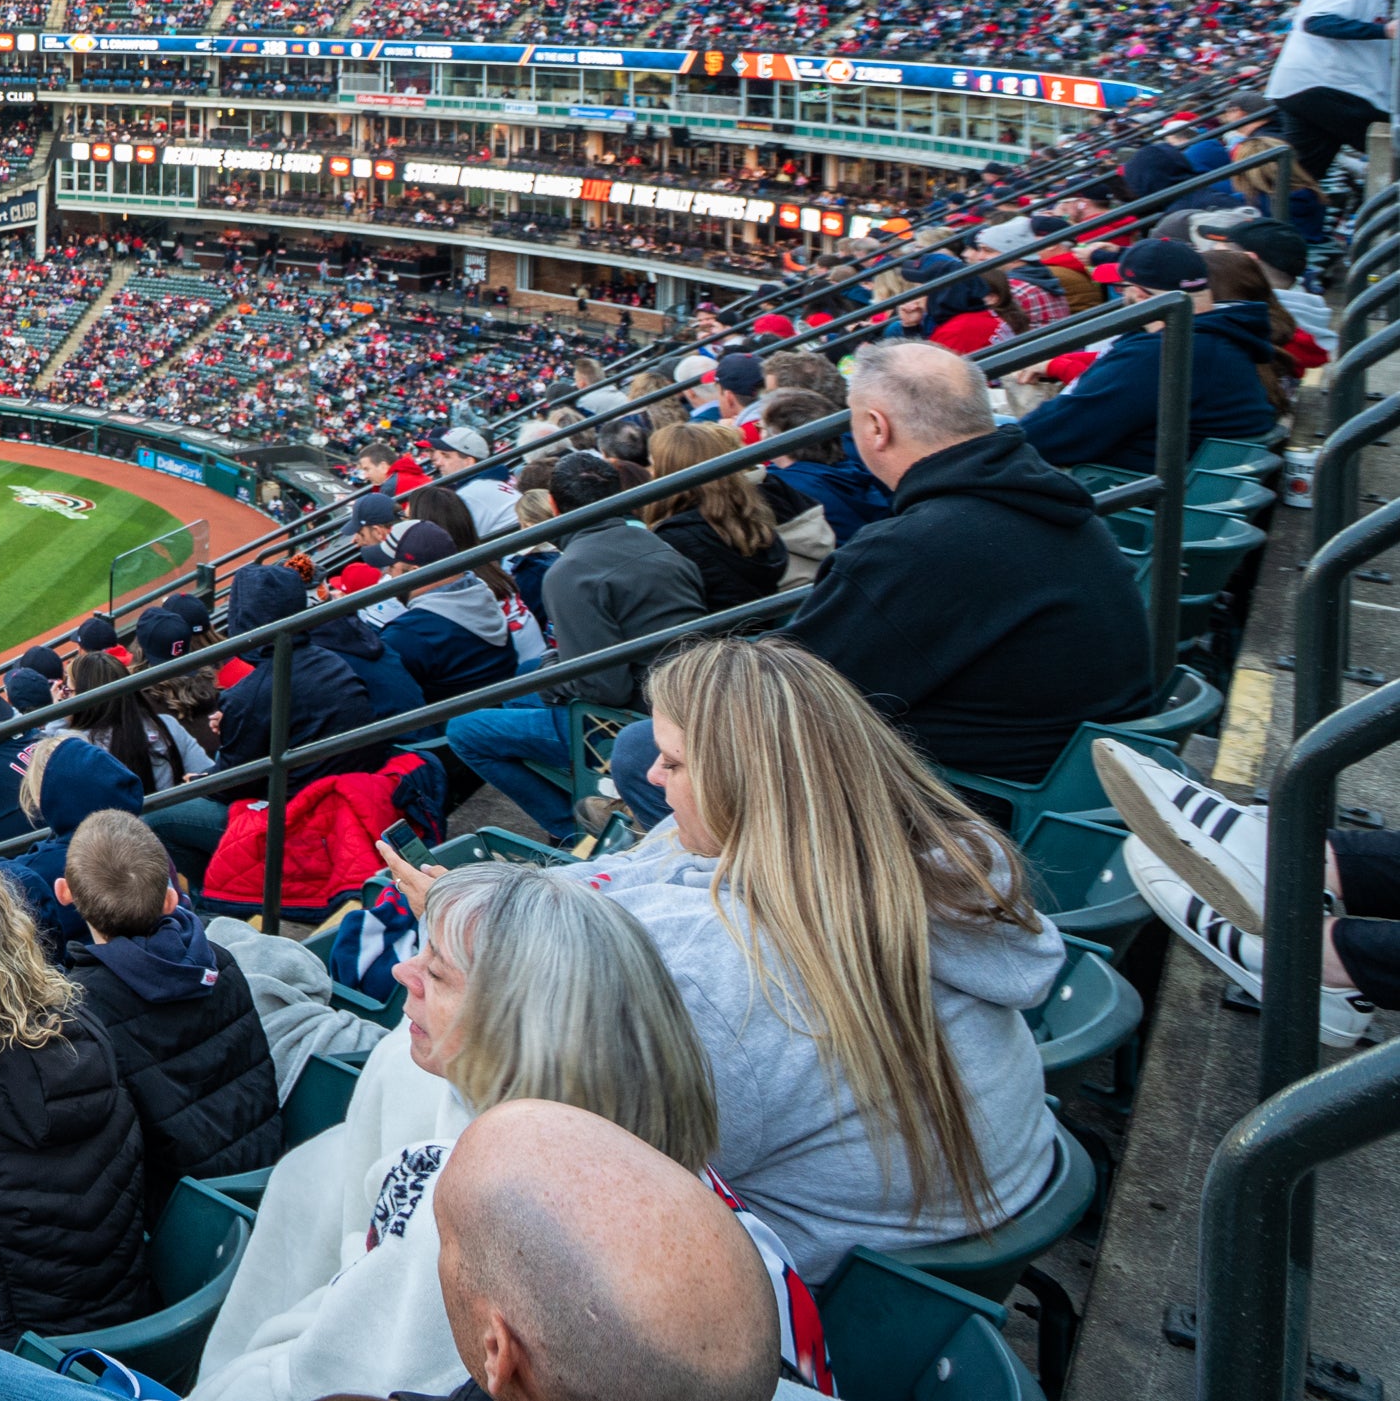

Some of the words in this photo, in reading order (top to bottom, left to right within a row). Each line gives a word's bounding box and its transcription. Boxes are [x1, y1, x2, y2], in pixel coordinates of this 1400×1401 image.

[756, 53, 774, 79] C
[6, 91, 36, 103] CLUB
[582, 178, 614, 204] LIVE
[10, 202, 37, 222] CLUB
[156, 455, 203, 482] DollarBank
[171, 640, 186, 657] C
